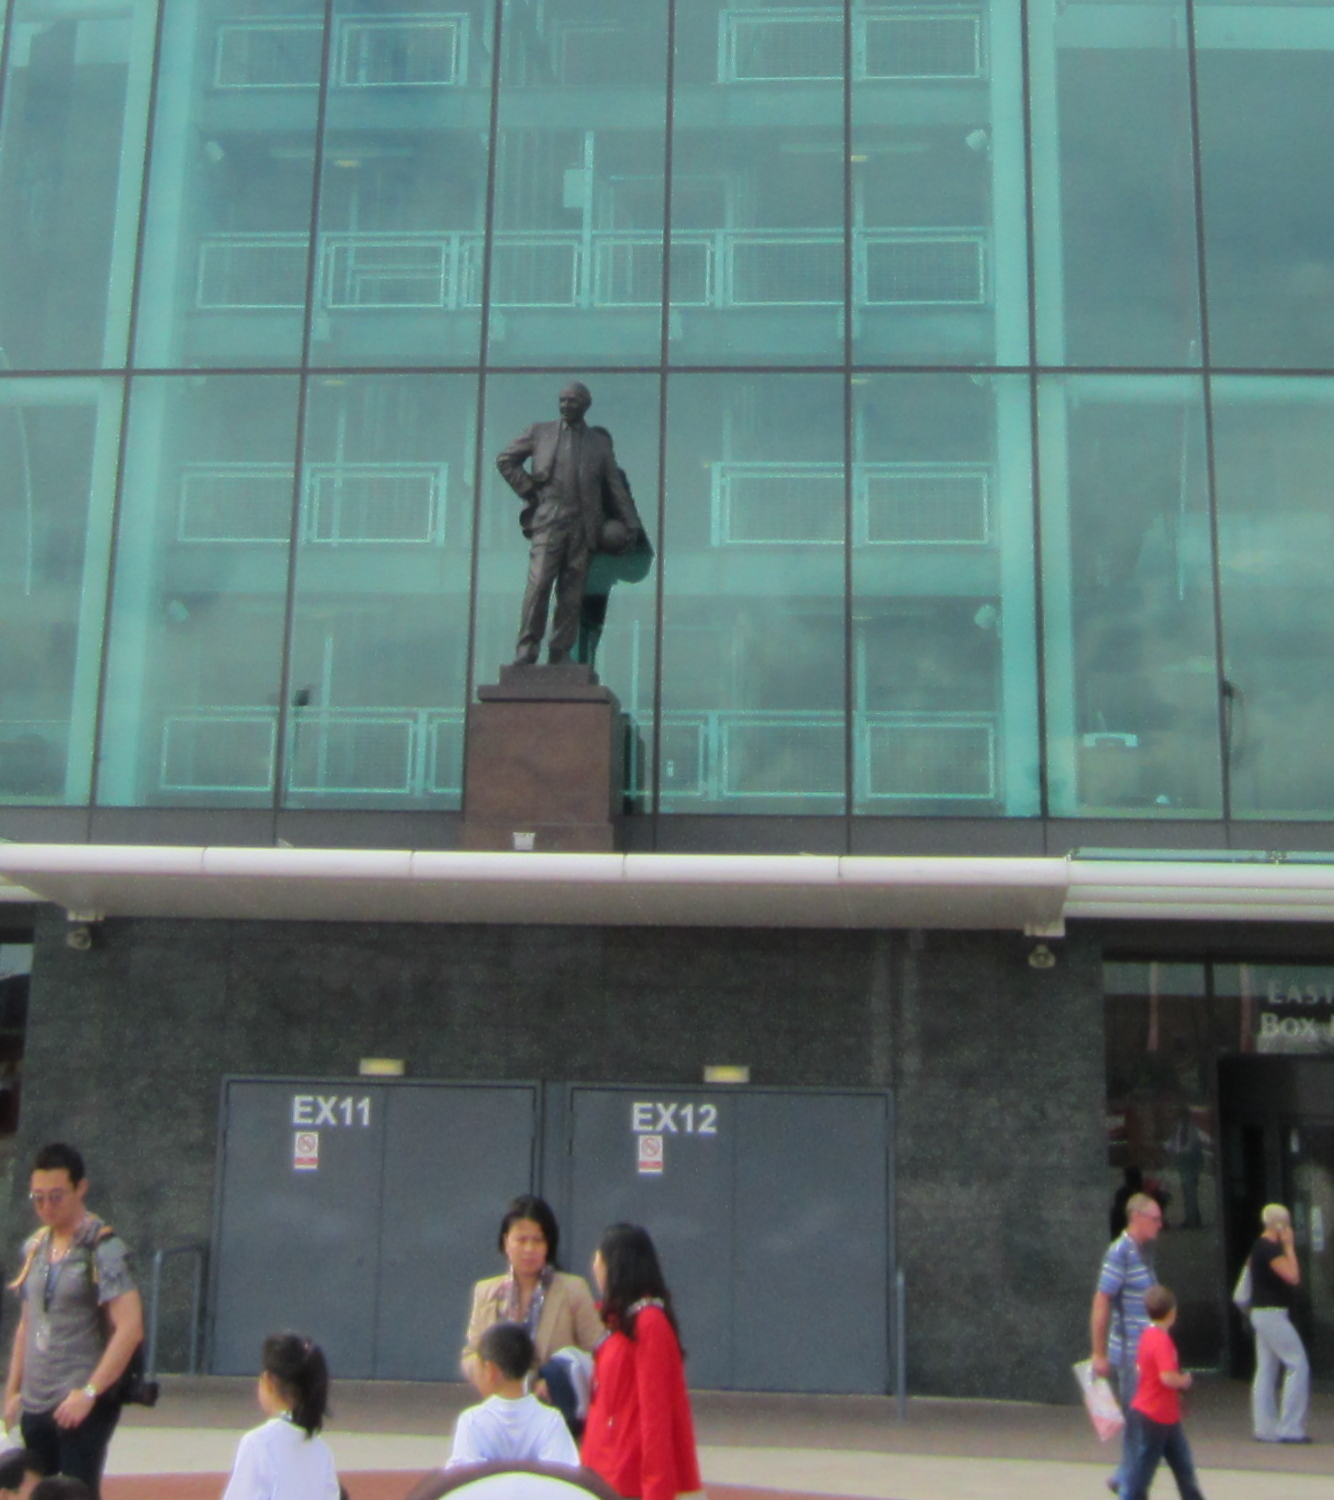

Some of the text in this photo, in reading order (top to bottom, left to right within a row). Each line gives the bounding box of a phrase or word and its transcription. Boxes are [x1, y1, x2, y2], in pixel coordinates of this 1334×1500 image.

[1269, 979, 1333, 1004] EAST
[1260, 1013, 1316, 1037] BOX
[292, 1095, 371, 1126] EX11
[633, 1102, 718, 1134] EX12
